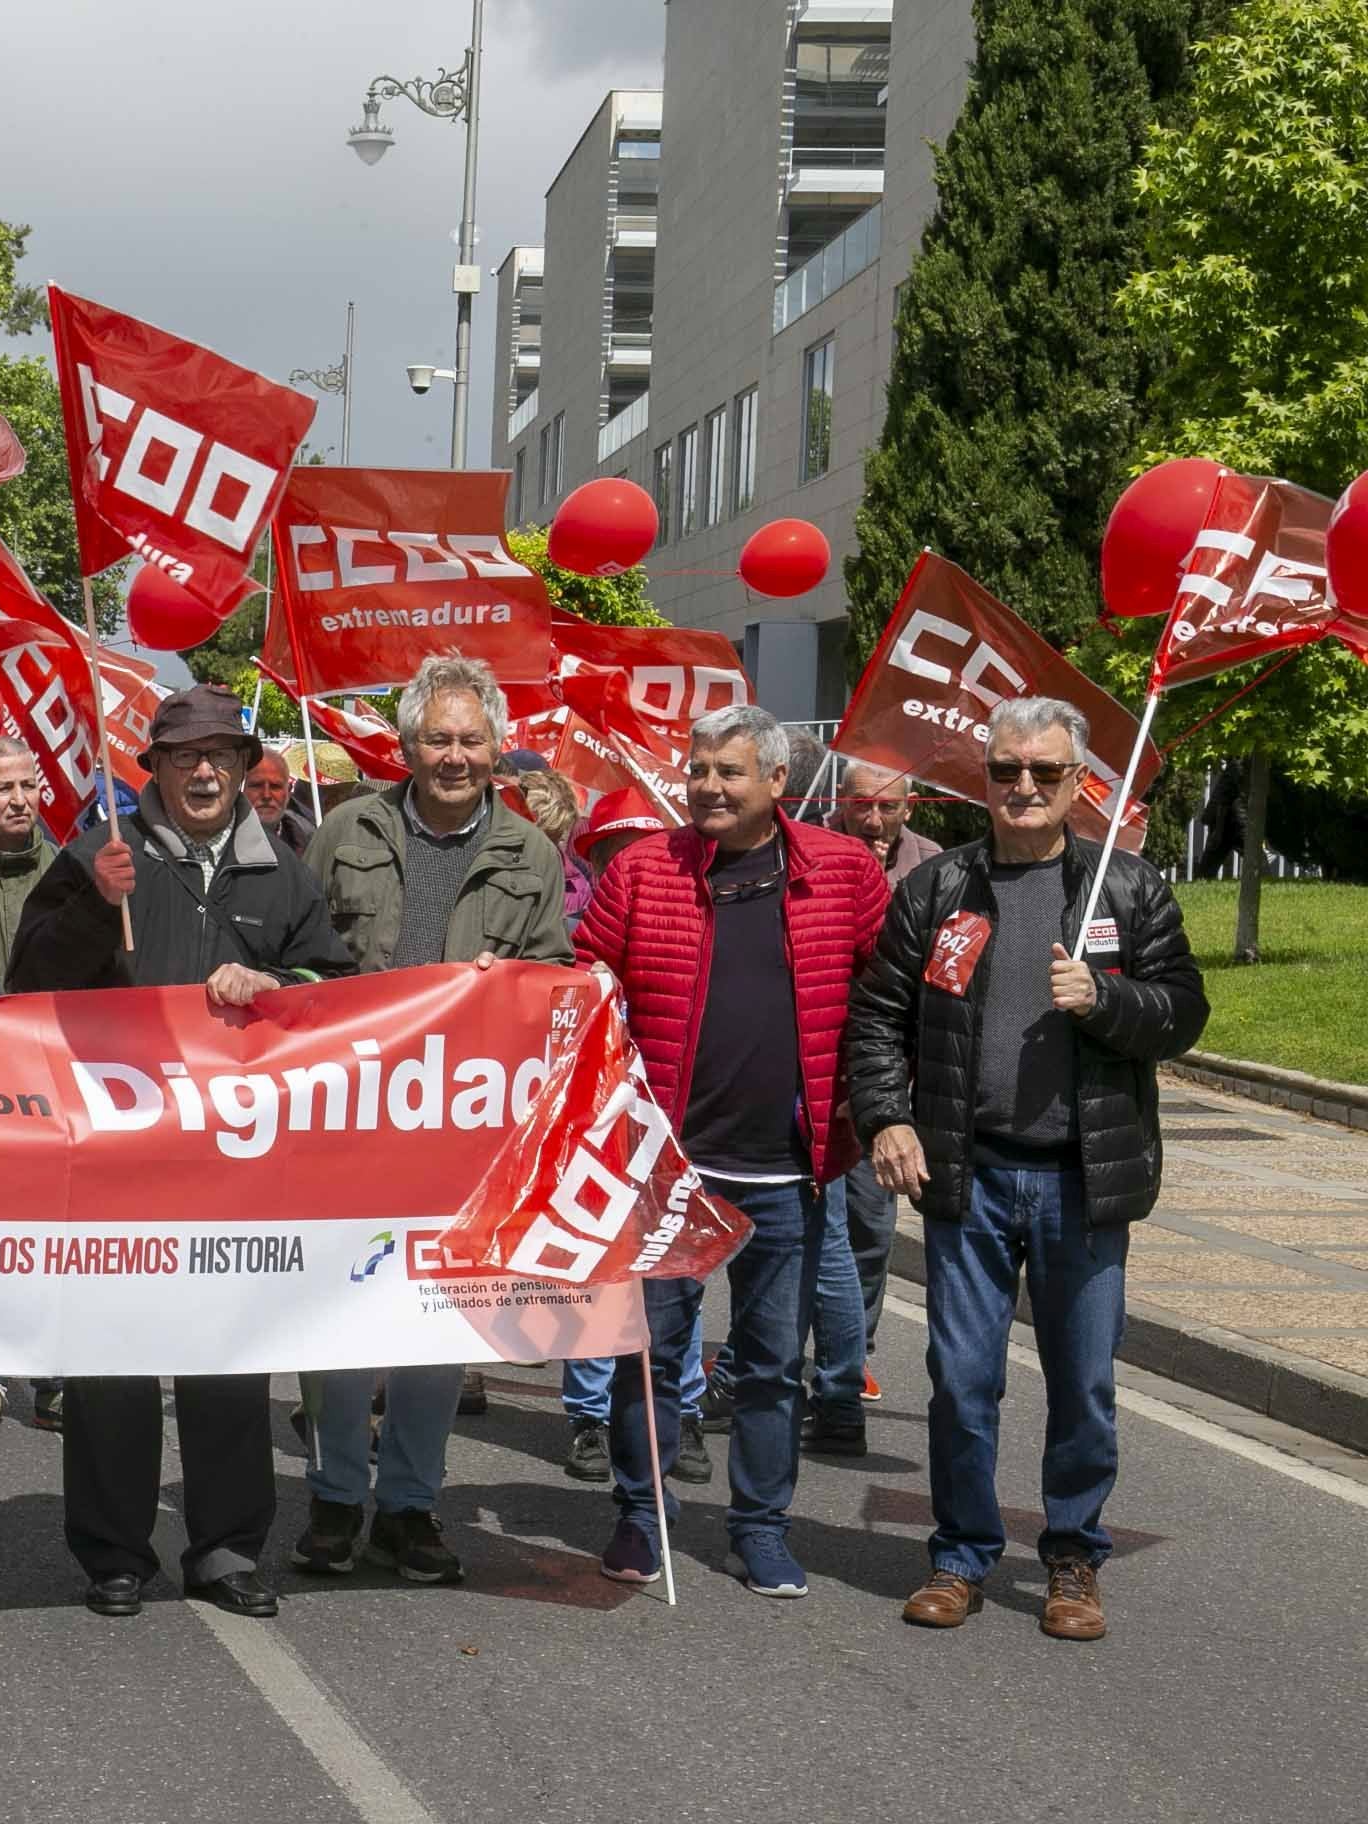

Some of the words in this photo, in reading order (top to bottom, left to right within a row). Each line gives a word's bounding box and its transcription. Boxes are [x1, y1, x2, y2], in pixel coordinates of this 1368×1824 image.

[289, 525, 533, 591] CCOO
[321, 601, 512, 632] extremadura
[902, 698, 989, 743] extre
[937, 928, 971, 955] PAZ
[552, 1009, 578, 1028] PAZ
[43, 1236, 179, 1275] HAREMOS
[188, 1235, 304, 1274] HISTORIA
[418, 1281, 485, 1296] federación
[491, 1280, 508, 1293] de
[421, 1301, 429, 1312] y
[432, 1296, 492, 1312] jubilados
[496, 1294, 512, 1306] de
[515, 1292, 592, 1305] extremadura
